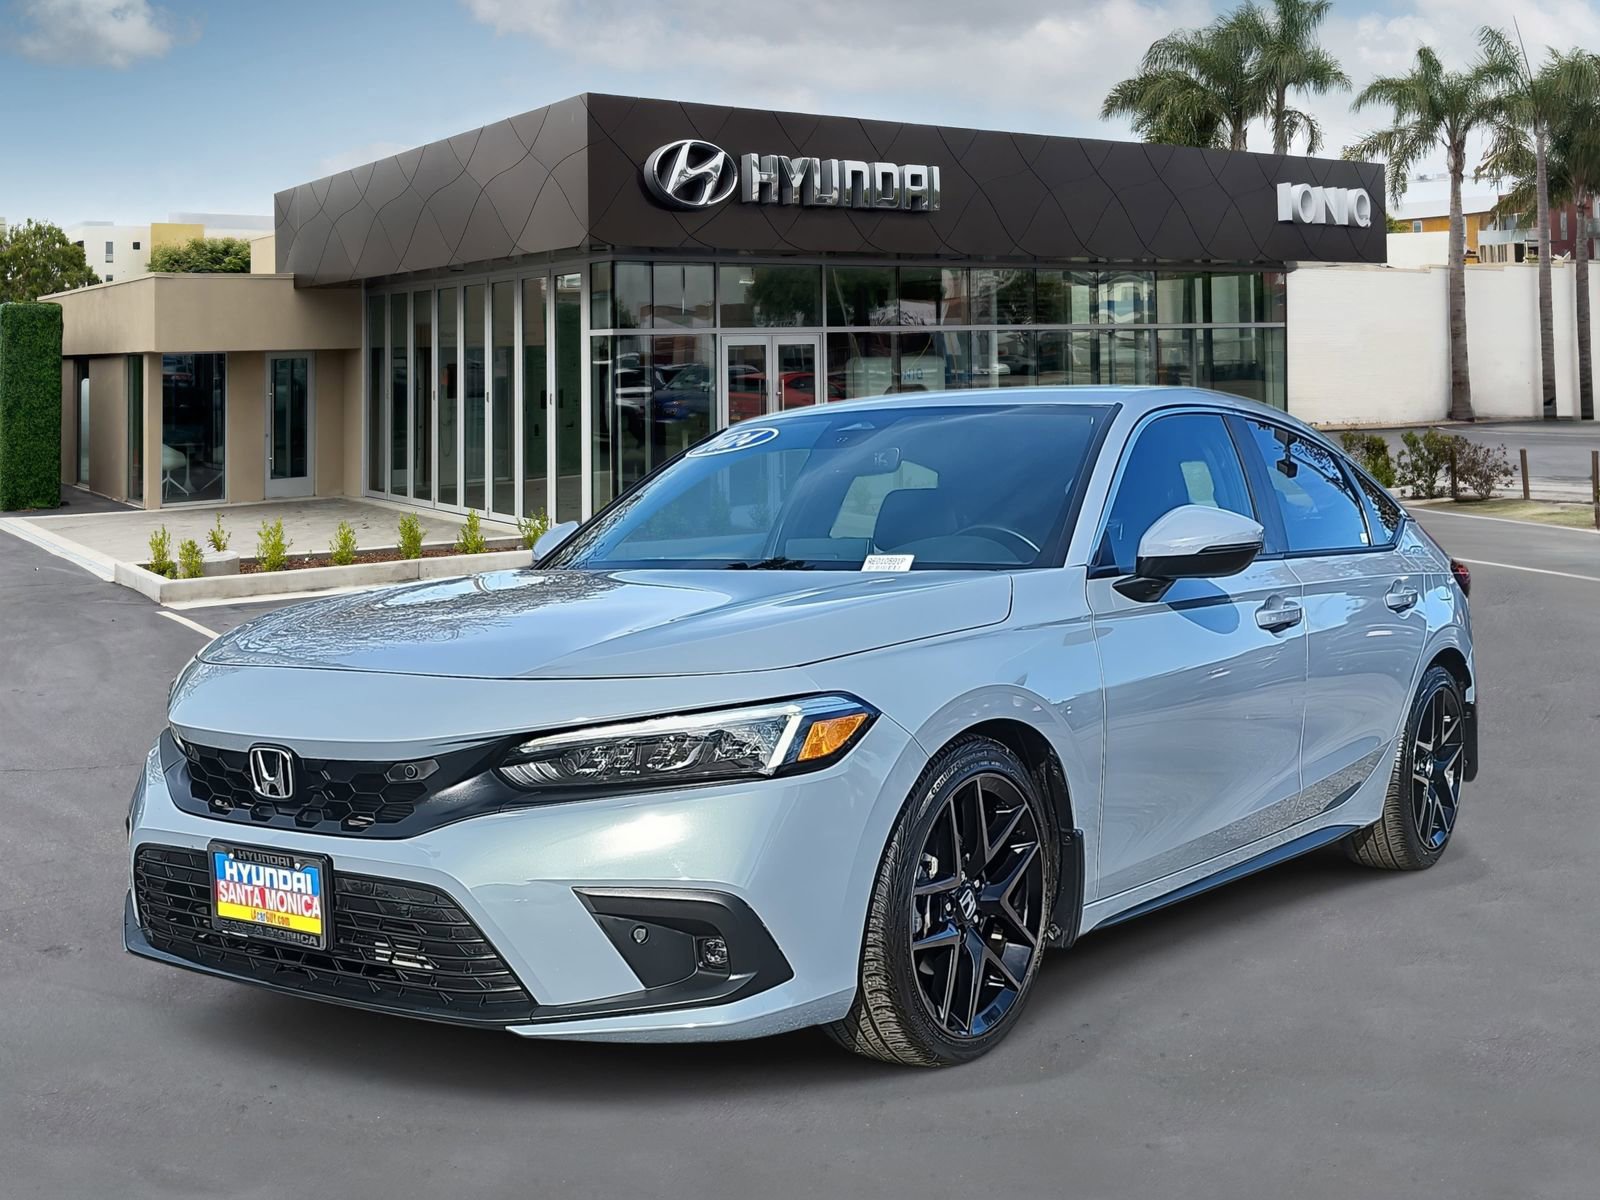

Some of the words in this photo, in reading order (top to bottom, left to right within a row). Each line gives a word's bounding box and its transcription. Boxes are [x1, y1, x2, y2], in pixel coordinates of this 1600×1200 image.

[741, 153, 940, 211] HYUNDAI
[1277, 182, 1371, 228] IONIQ
[238, 850, 290, 867] HYUNDAI
[224, 860, 313, 895] HYUNDAI
[219, 880, 264, 909] SANTA
[264, 888, 321, 919] MONICA
[265, 926, 318, 946] MONICA
